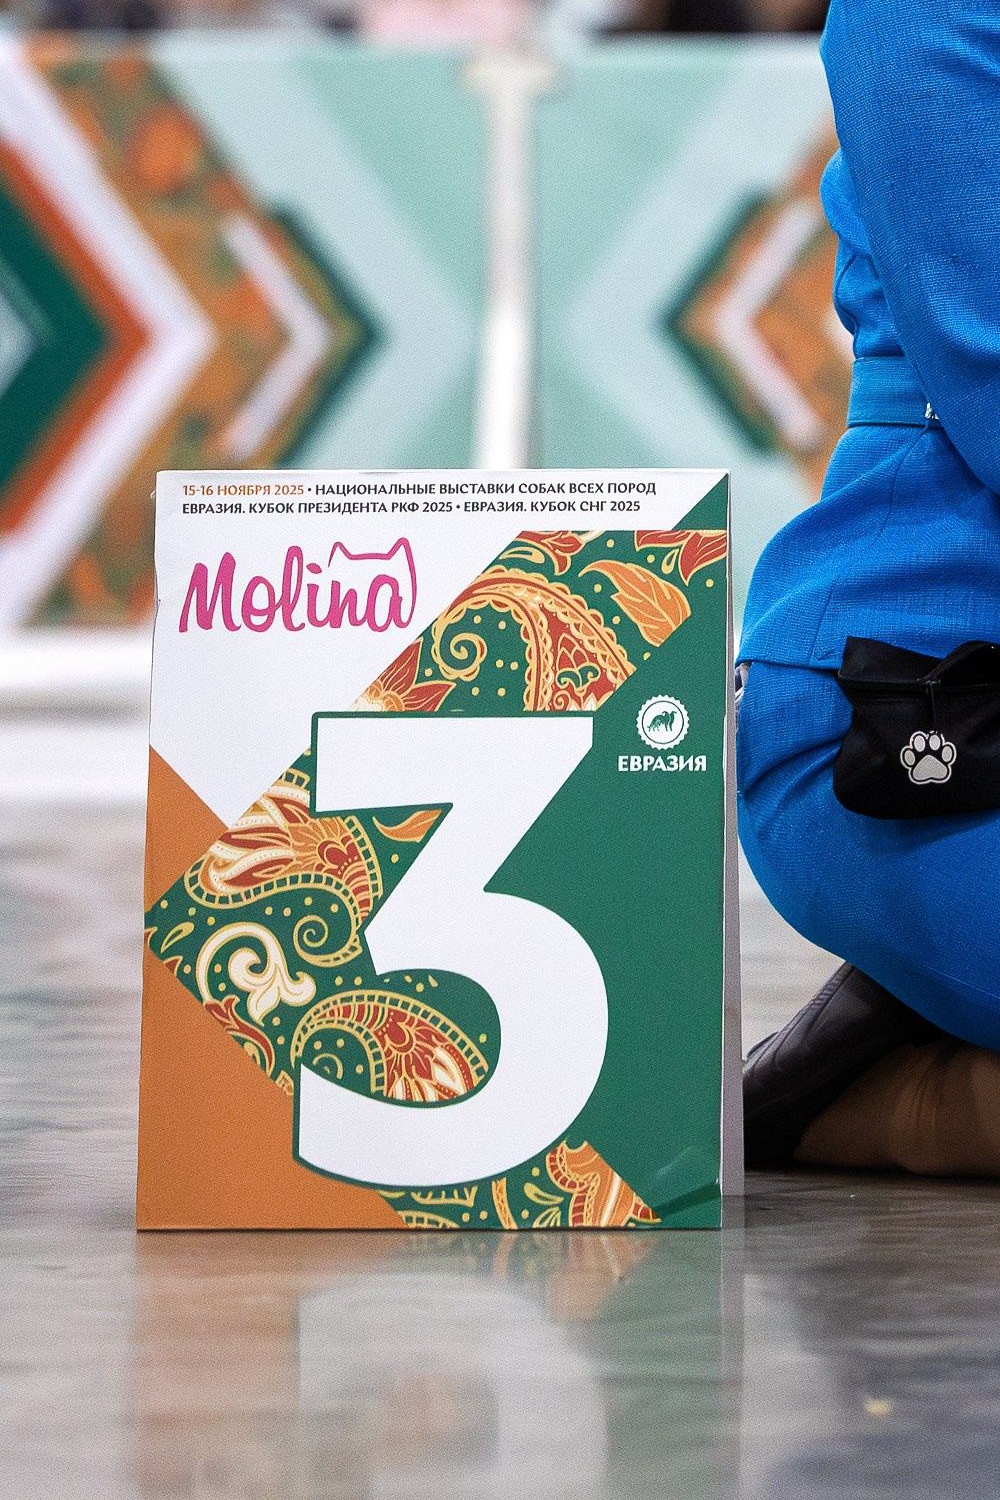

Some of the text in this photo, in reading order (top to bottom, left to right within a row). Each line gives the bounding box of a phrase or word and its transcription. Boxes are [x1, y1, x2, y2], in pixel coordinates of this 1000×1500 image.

[182, 482, 656, 496] 15-16 НОЯБРЯ 2025 НАЦИОНАЛЬНЫЕ ВЫСТАВКИ СОБАК ВСЕХ ПОРОД
[182, 501, 640, 515] ЕВРАЗИЯ. КУБОК ПРЕЗИДЕНТА РКФ 2025 ЕВРАЗИЯ. КУБОК СНГ 2025
[179, 537, 417, 632] Molina
[618, 755, 707, 772] ЕВРАЗИЯ
[298, 713, 609, 1188] 3
